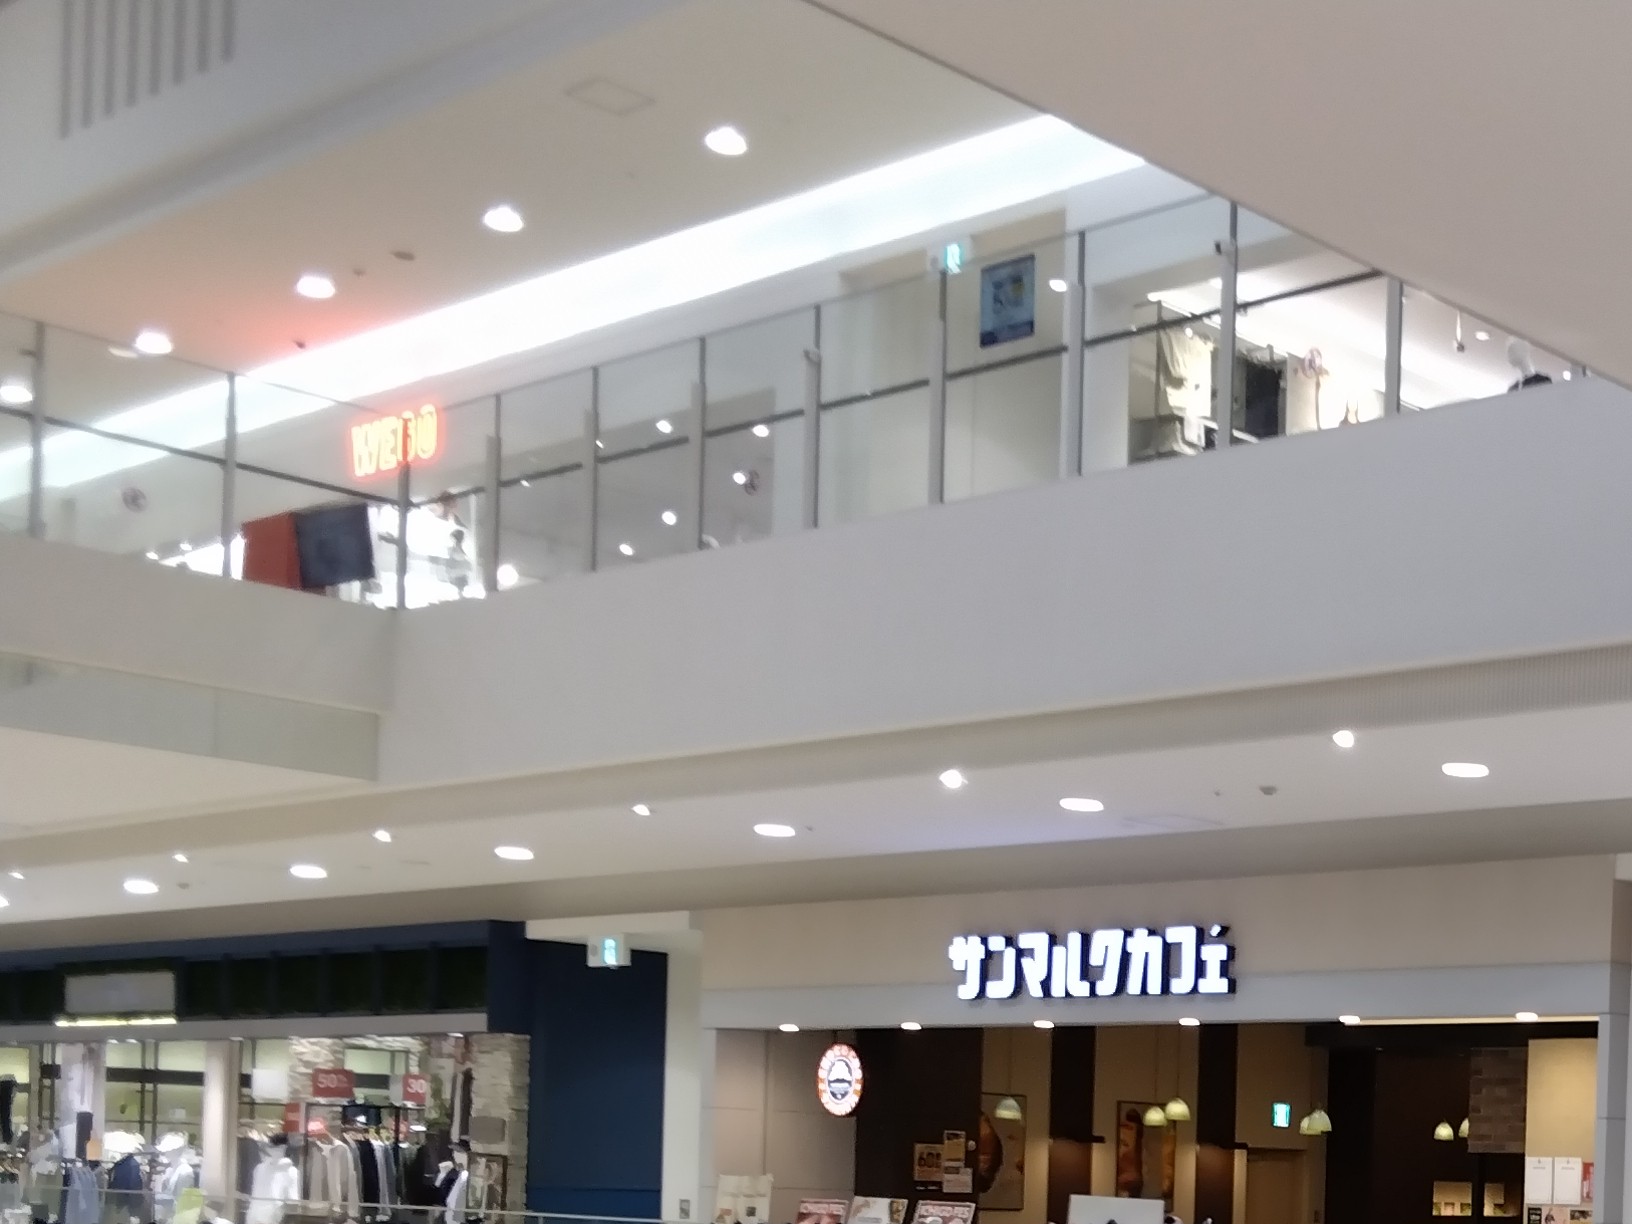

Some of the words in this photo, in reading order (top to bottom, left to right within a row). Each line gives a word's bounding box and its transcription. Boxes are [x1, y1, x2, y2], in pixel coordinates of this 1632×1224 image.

[949, 924, 1233, 1000] サンマルクカフェ
